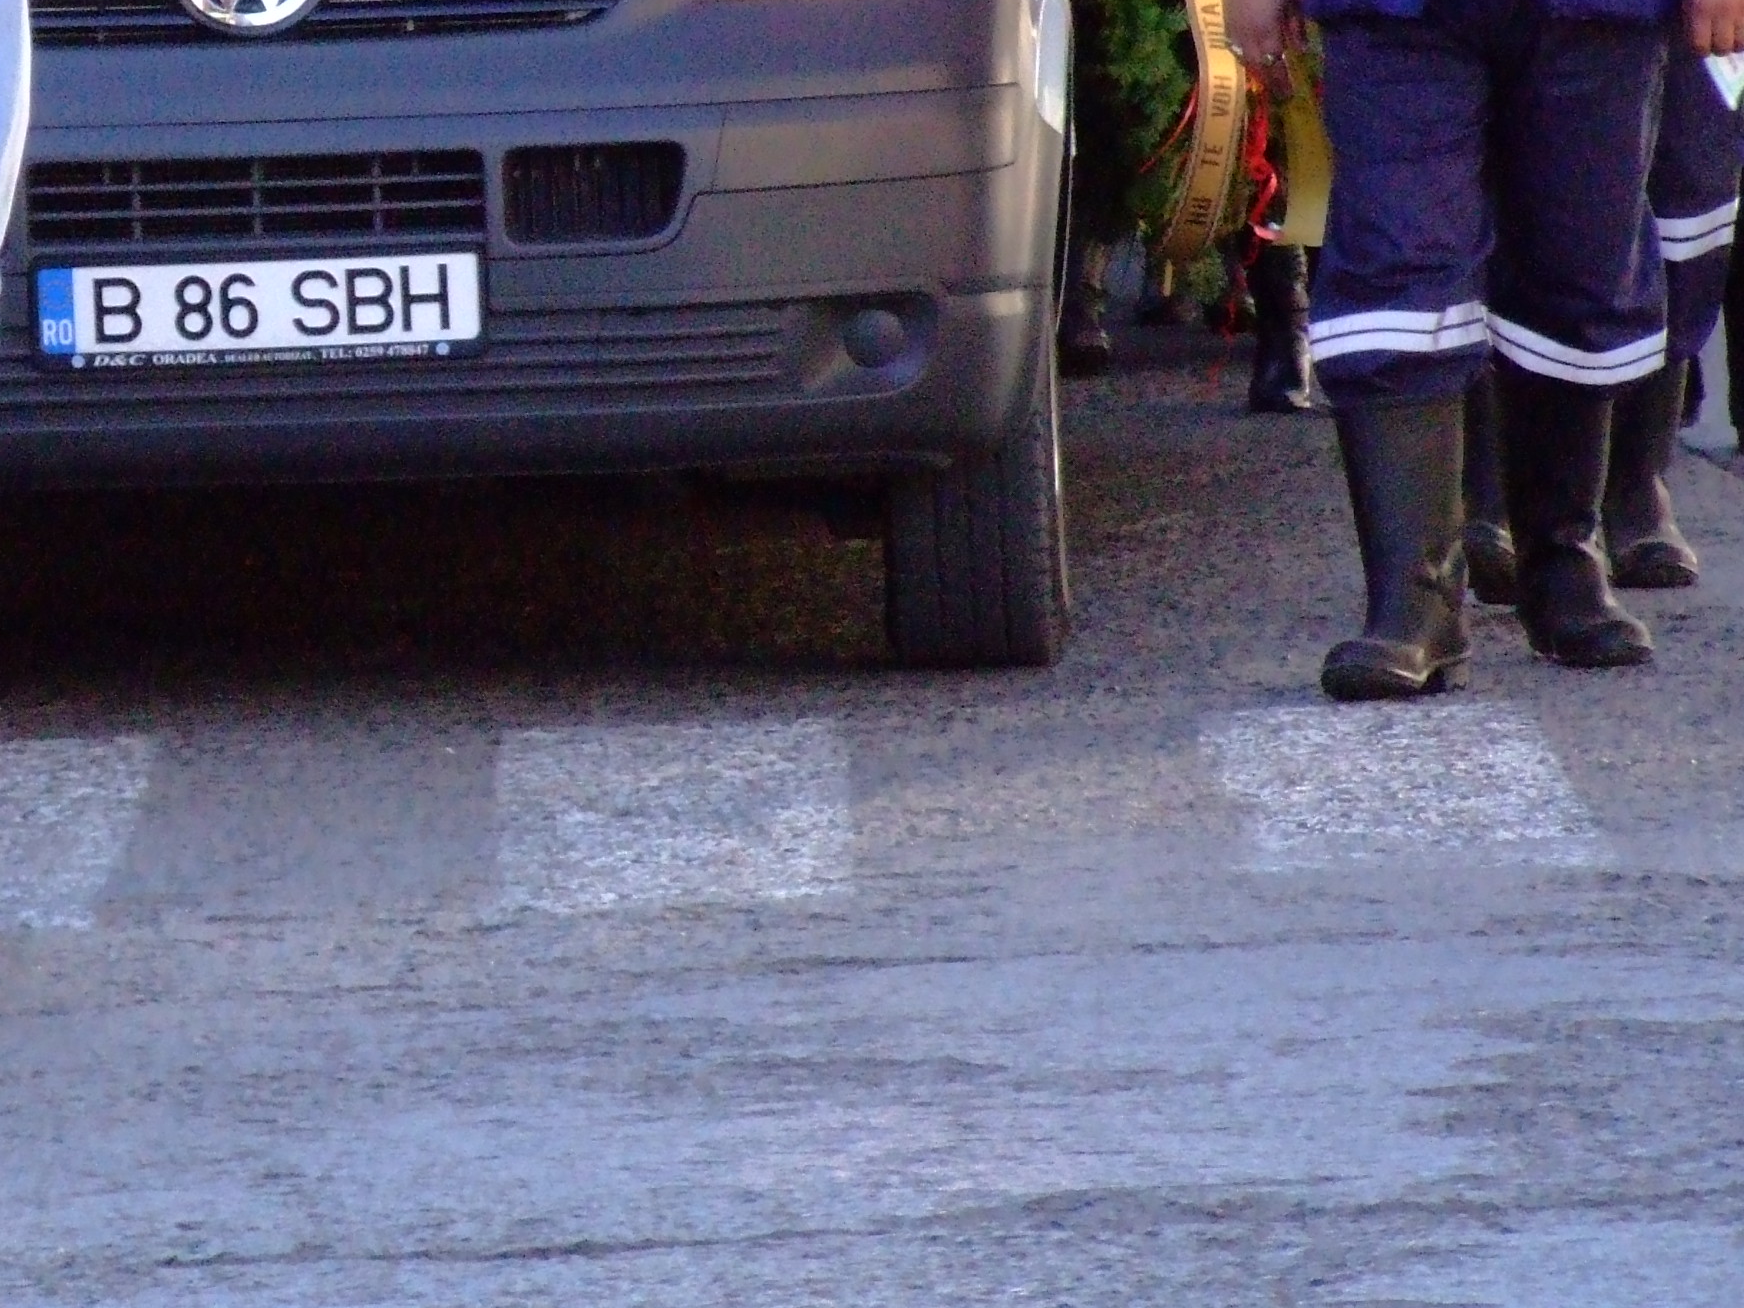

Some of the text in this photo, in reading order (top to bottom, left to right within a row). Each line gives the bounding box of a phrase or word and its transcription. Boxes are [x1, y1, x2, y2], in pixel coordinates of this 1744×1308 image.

[1200, 145, 1224, 167] TE
[93, 263, 450, 344] B 86 SBH
[42, 318, 73, 346] RO
[152, 352, 218, 366] ORADEA
